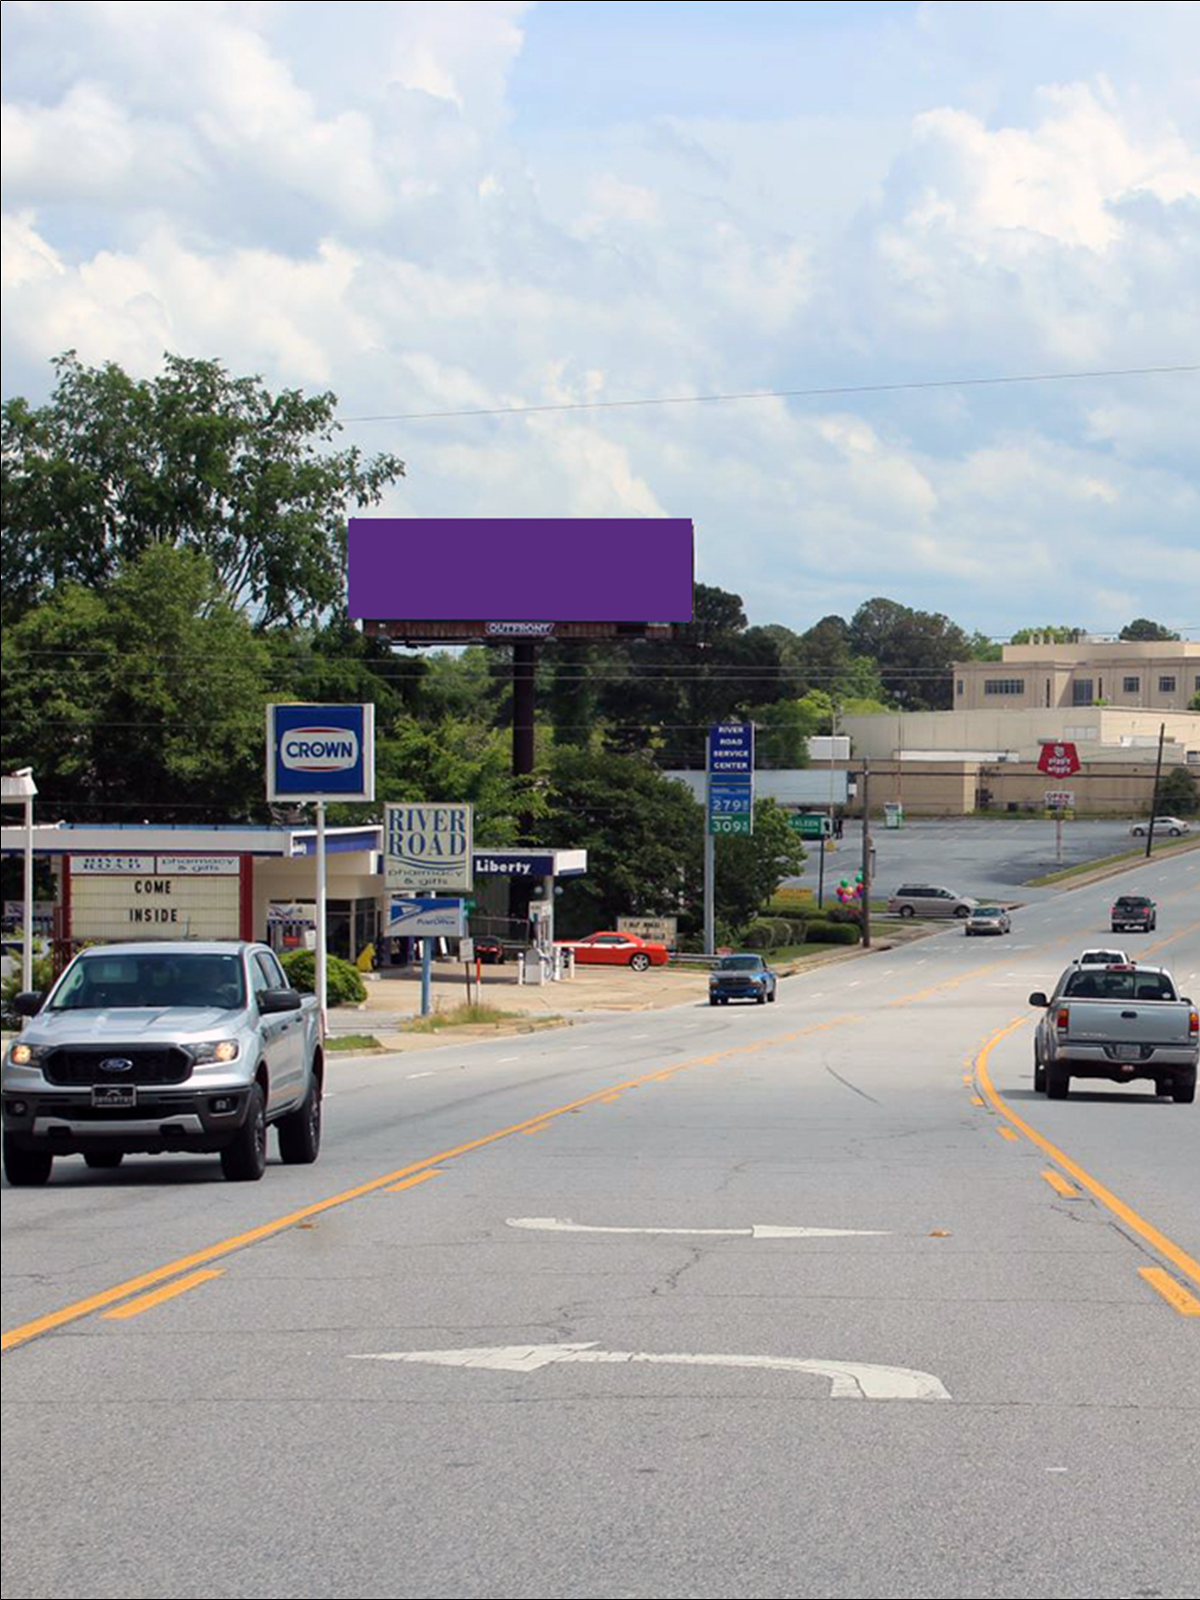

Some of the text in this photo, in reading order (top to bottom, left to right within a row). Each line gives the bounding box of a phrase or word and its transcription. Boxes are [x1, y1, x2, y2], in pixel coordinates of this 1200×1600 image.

[718, 726, 744, 734] RIVER
[719, 738, 743, 746] ROAD
[286, 742, 353, 758] CROWN
[713, 750, 749, 758] SERVICE
[713, 762, 748, 770] CENTER
[388, 808, 466, 832] RIVER
[388, 832, 467, 856] ROAD
[475, 860, 531, 875] Liberty
[134, 880, 172, 894] COME
[129, 908, 178, 923] INSIDE
